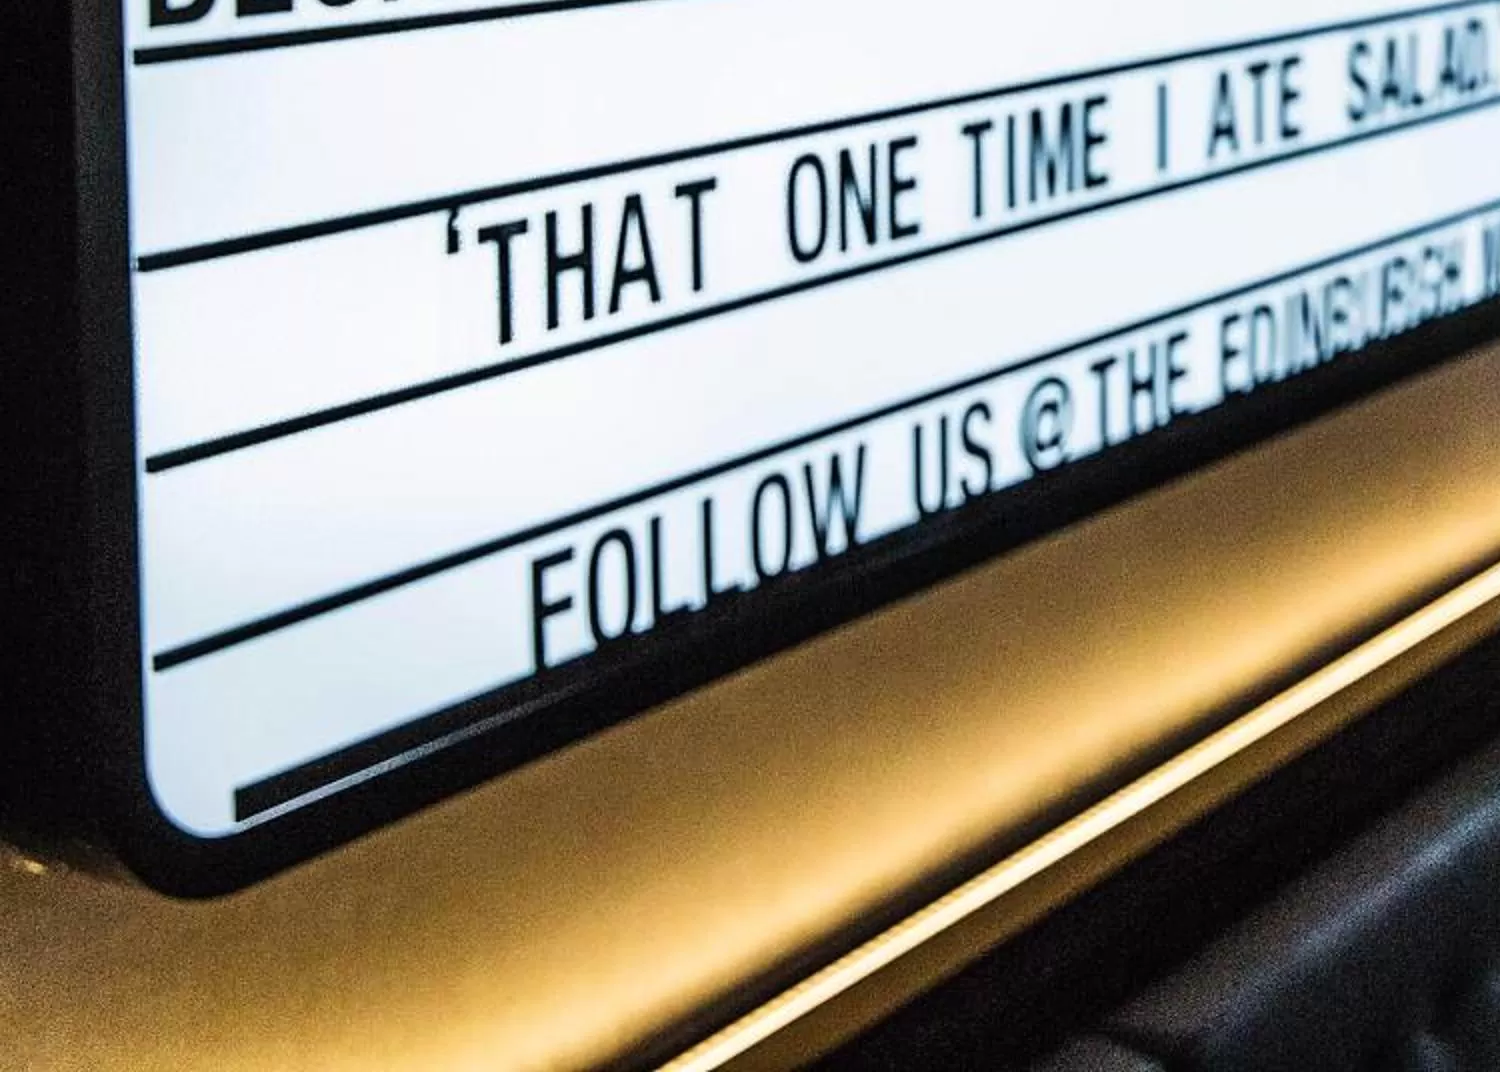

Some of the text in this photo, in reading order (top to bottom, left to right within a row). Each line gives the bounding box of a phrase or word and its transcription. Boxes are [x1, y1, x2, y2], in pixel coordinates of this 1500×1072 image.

[786, 136, 919, 264] ONE
[960, 95, 1109, 218] TIME
[1156, 82, 1170, 172] I
[1205, 55, 1302, 159] ATE
[530, 443, 867, 672] FOLLOW
[912, 400, 994, 516] US
